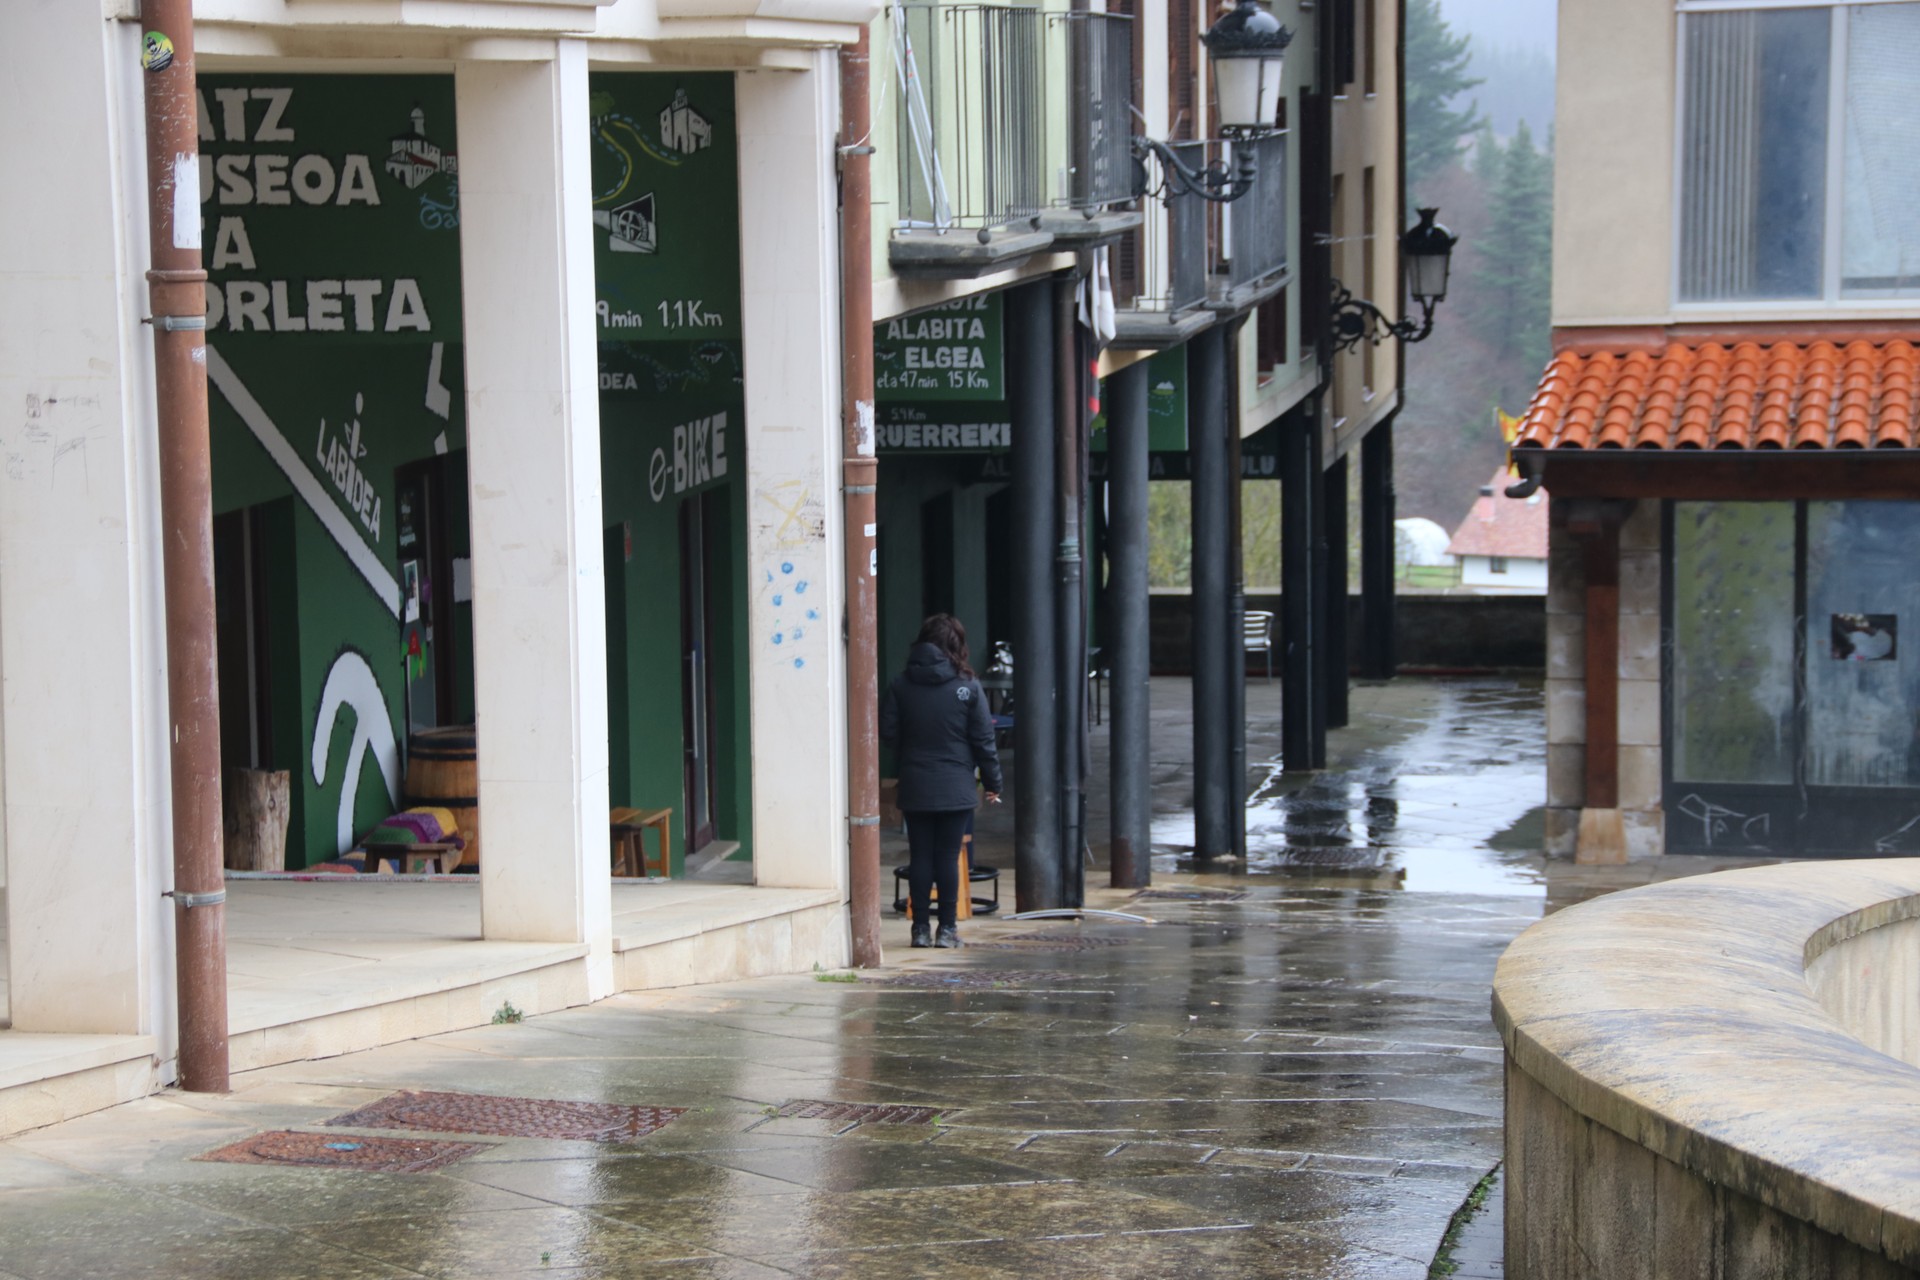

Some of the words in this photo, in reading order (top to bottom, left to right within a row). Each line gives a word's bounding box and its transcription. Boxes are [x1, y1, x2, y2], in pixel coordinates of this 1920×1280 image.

[887, 317, 986, 340] ALABITA
[905, 346, 985, 369] ELGEA
[316, 417, 381, 543] LABIDEA
